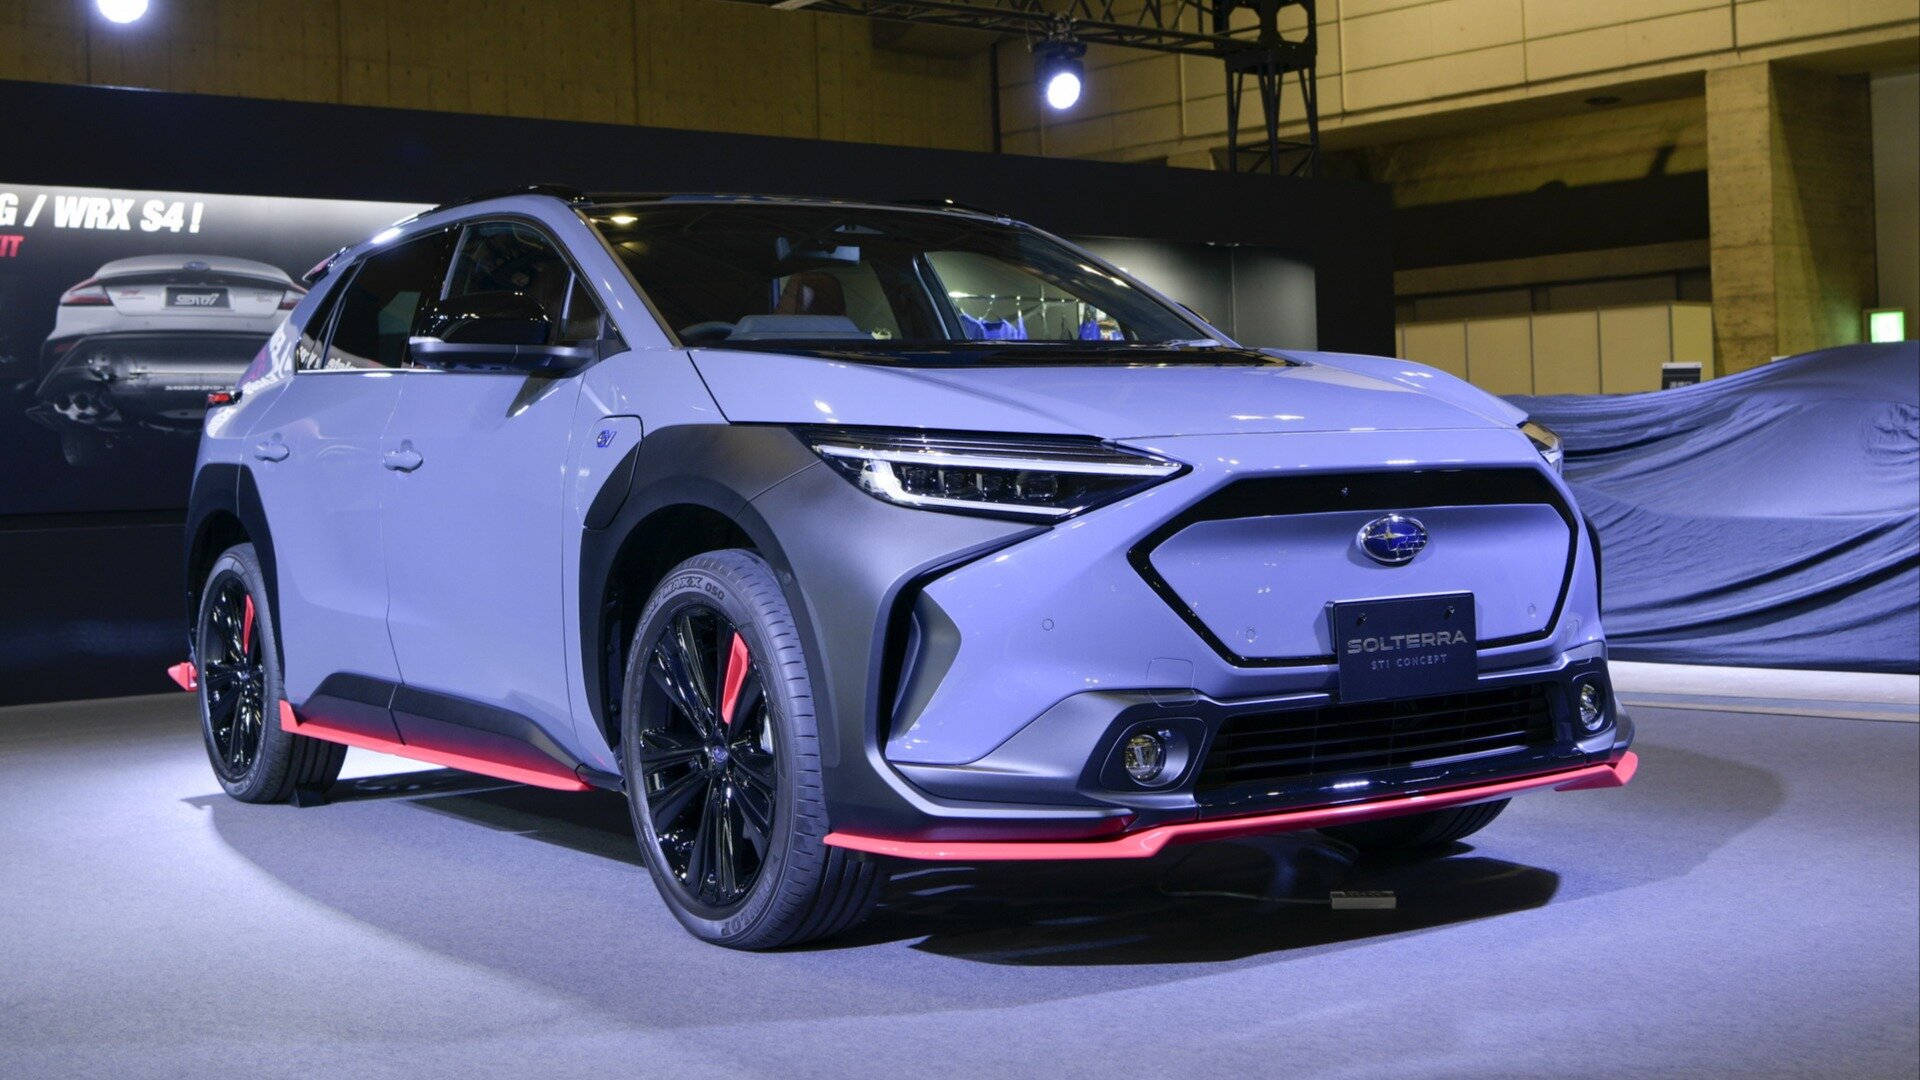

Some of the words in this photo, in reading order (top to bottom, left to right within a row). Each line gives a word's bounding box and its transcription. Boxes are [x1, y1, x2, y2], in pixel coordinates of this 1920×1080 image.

[54, 195, 135, 230] WRX
[1347, 630, 1468, 654] SOLTERRA
[1371, 659, 1390, 670] STI
[1396, 654, 1447, 667] CONCEPT
